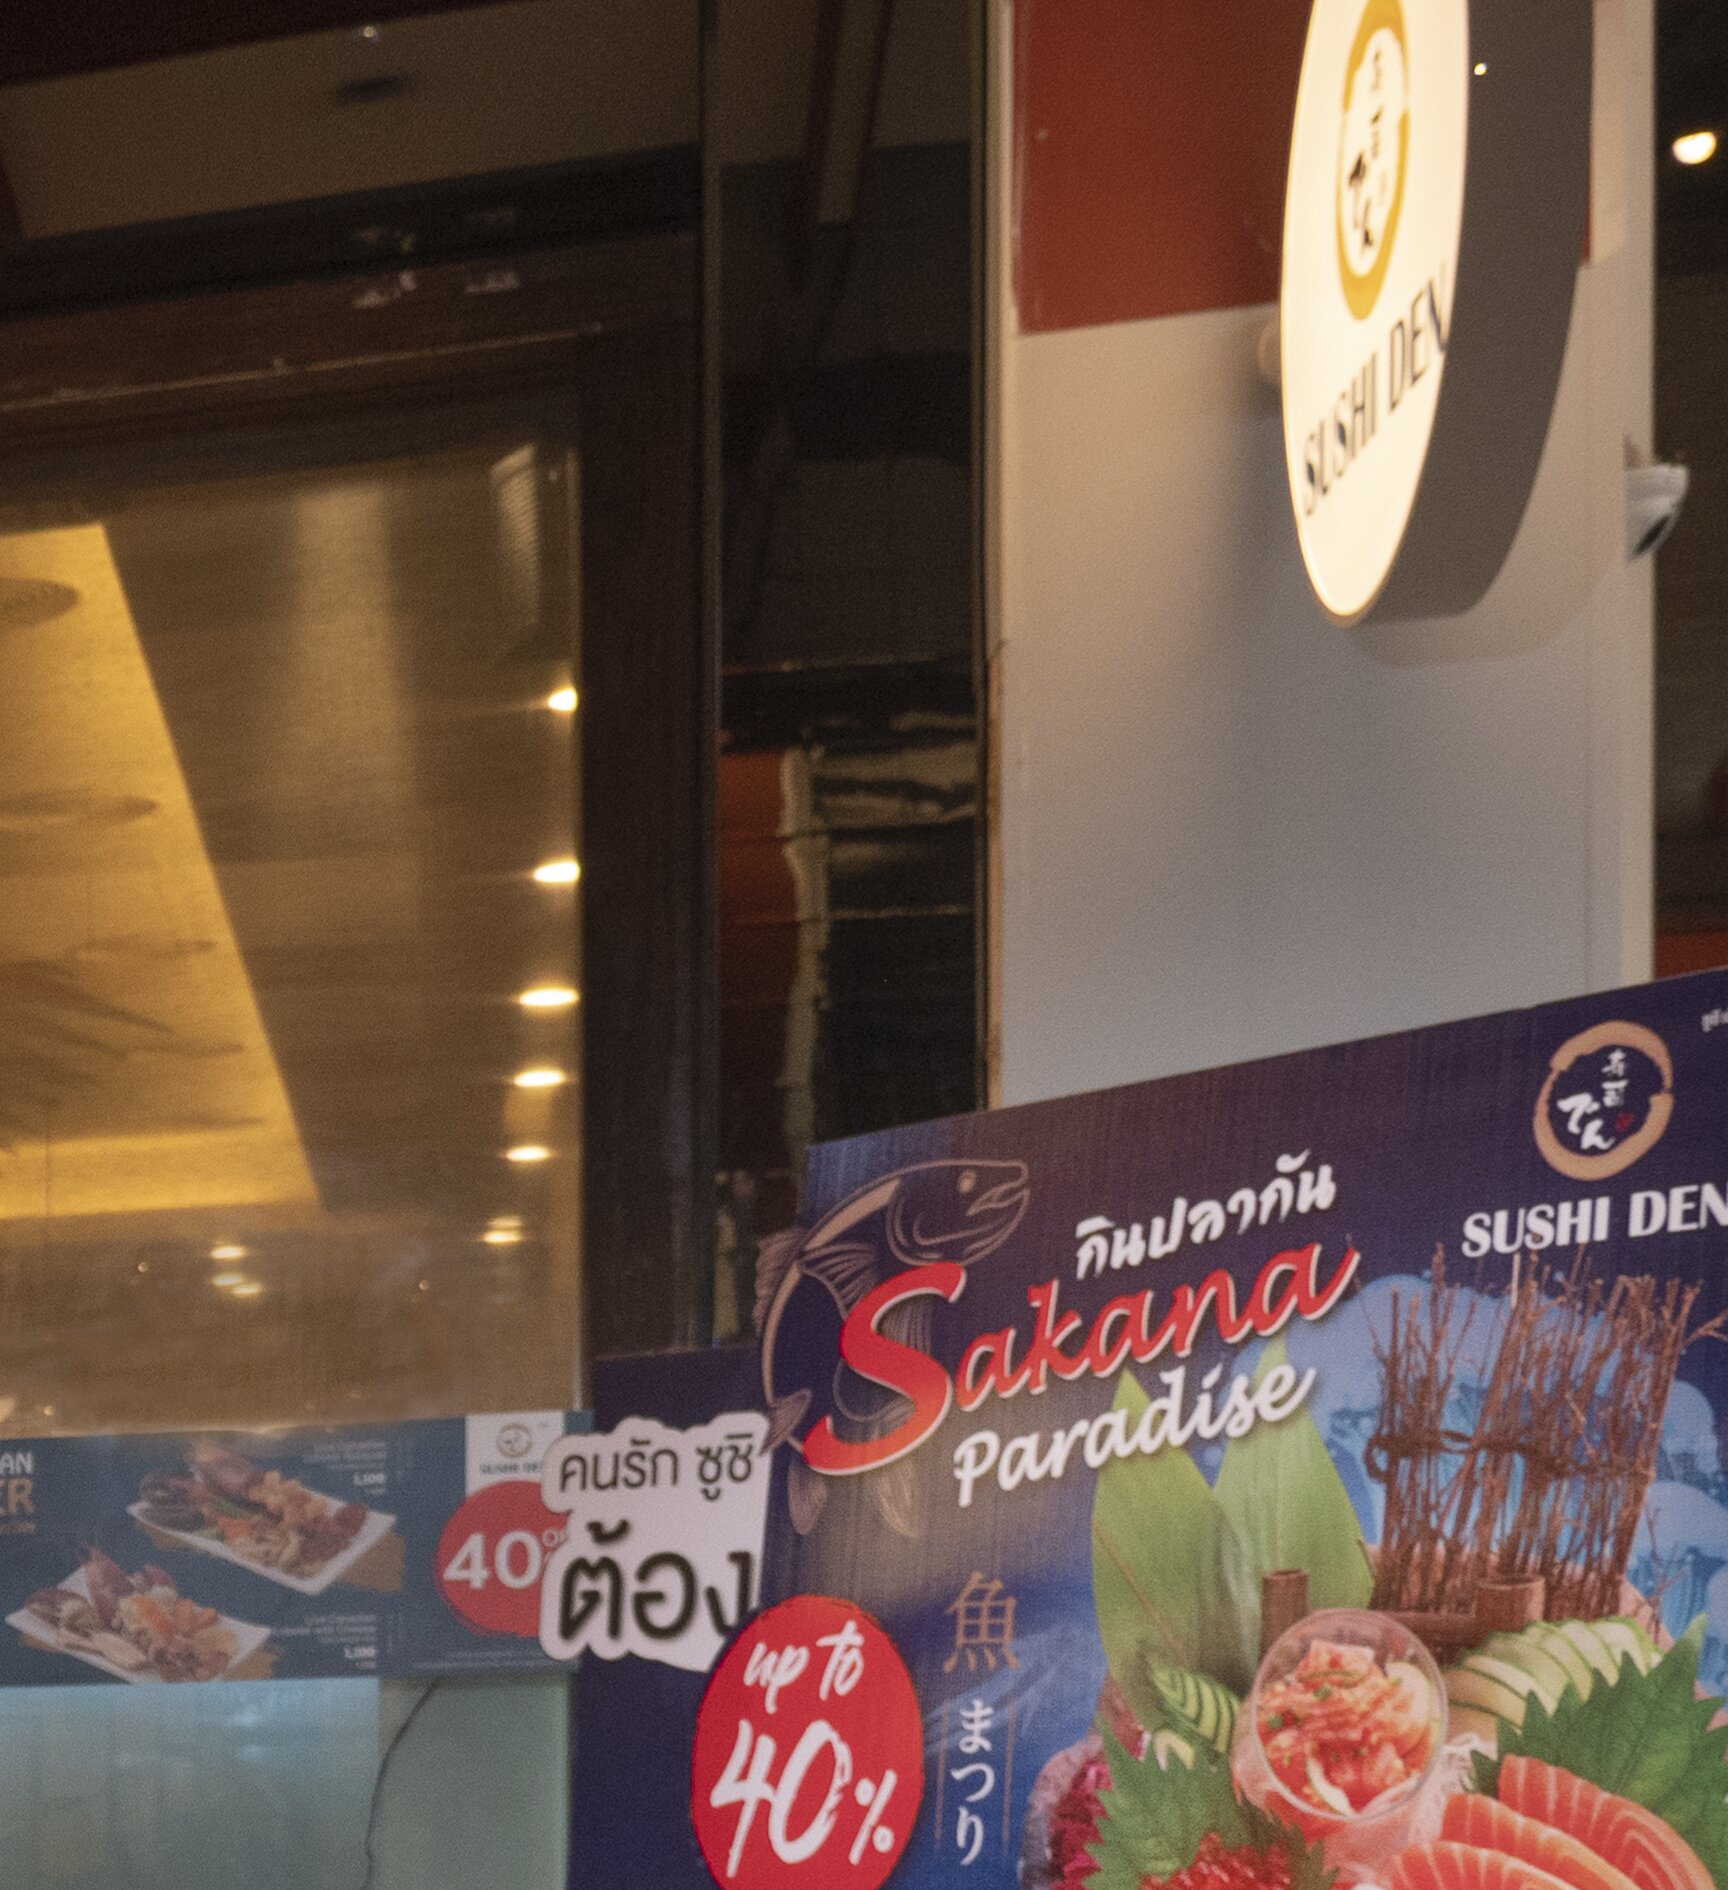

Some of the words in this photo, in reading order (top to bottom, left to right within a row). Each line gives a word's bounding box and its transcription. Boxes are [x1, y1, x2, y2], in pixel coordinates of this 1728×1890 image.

[1302, 350, 1378, 518] SUSHI
[1075, 1149, 1338, 1281] กินปลากัน
[1461, 1196, 1611, 1258] SUSHI
[1628, 1182, 1728, 1239] DEN
[802, 1233, 1361, 1477] Sakana
[559, 1438, 679, 1494] คนรัก
[696, 1431, 754, 1502] ซูชิ
[954, 1363, 1317, 1508] Paradise
[558, 1518, 756, 1642] ต้อง
[944, 1571, 1020, 1673] 魚
[743, 1640, 810, 1715] up
[816, 1619, 865, 1702] to
[709, 1718, 898, 1879] 40%
[950, 1699, 995, 1867] まつり
